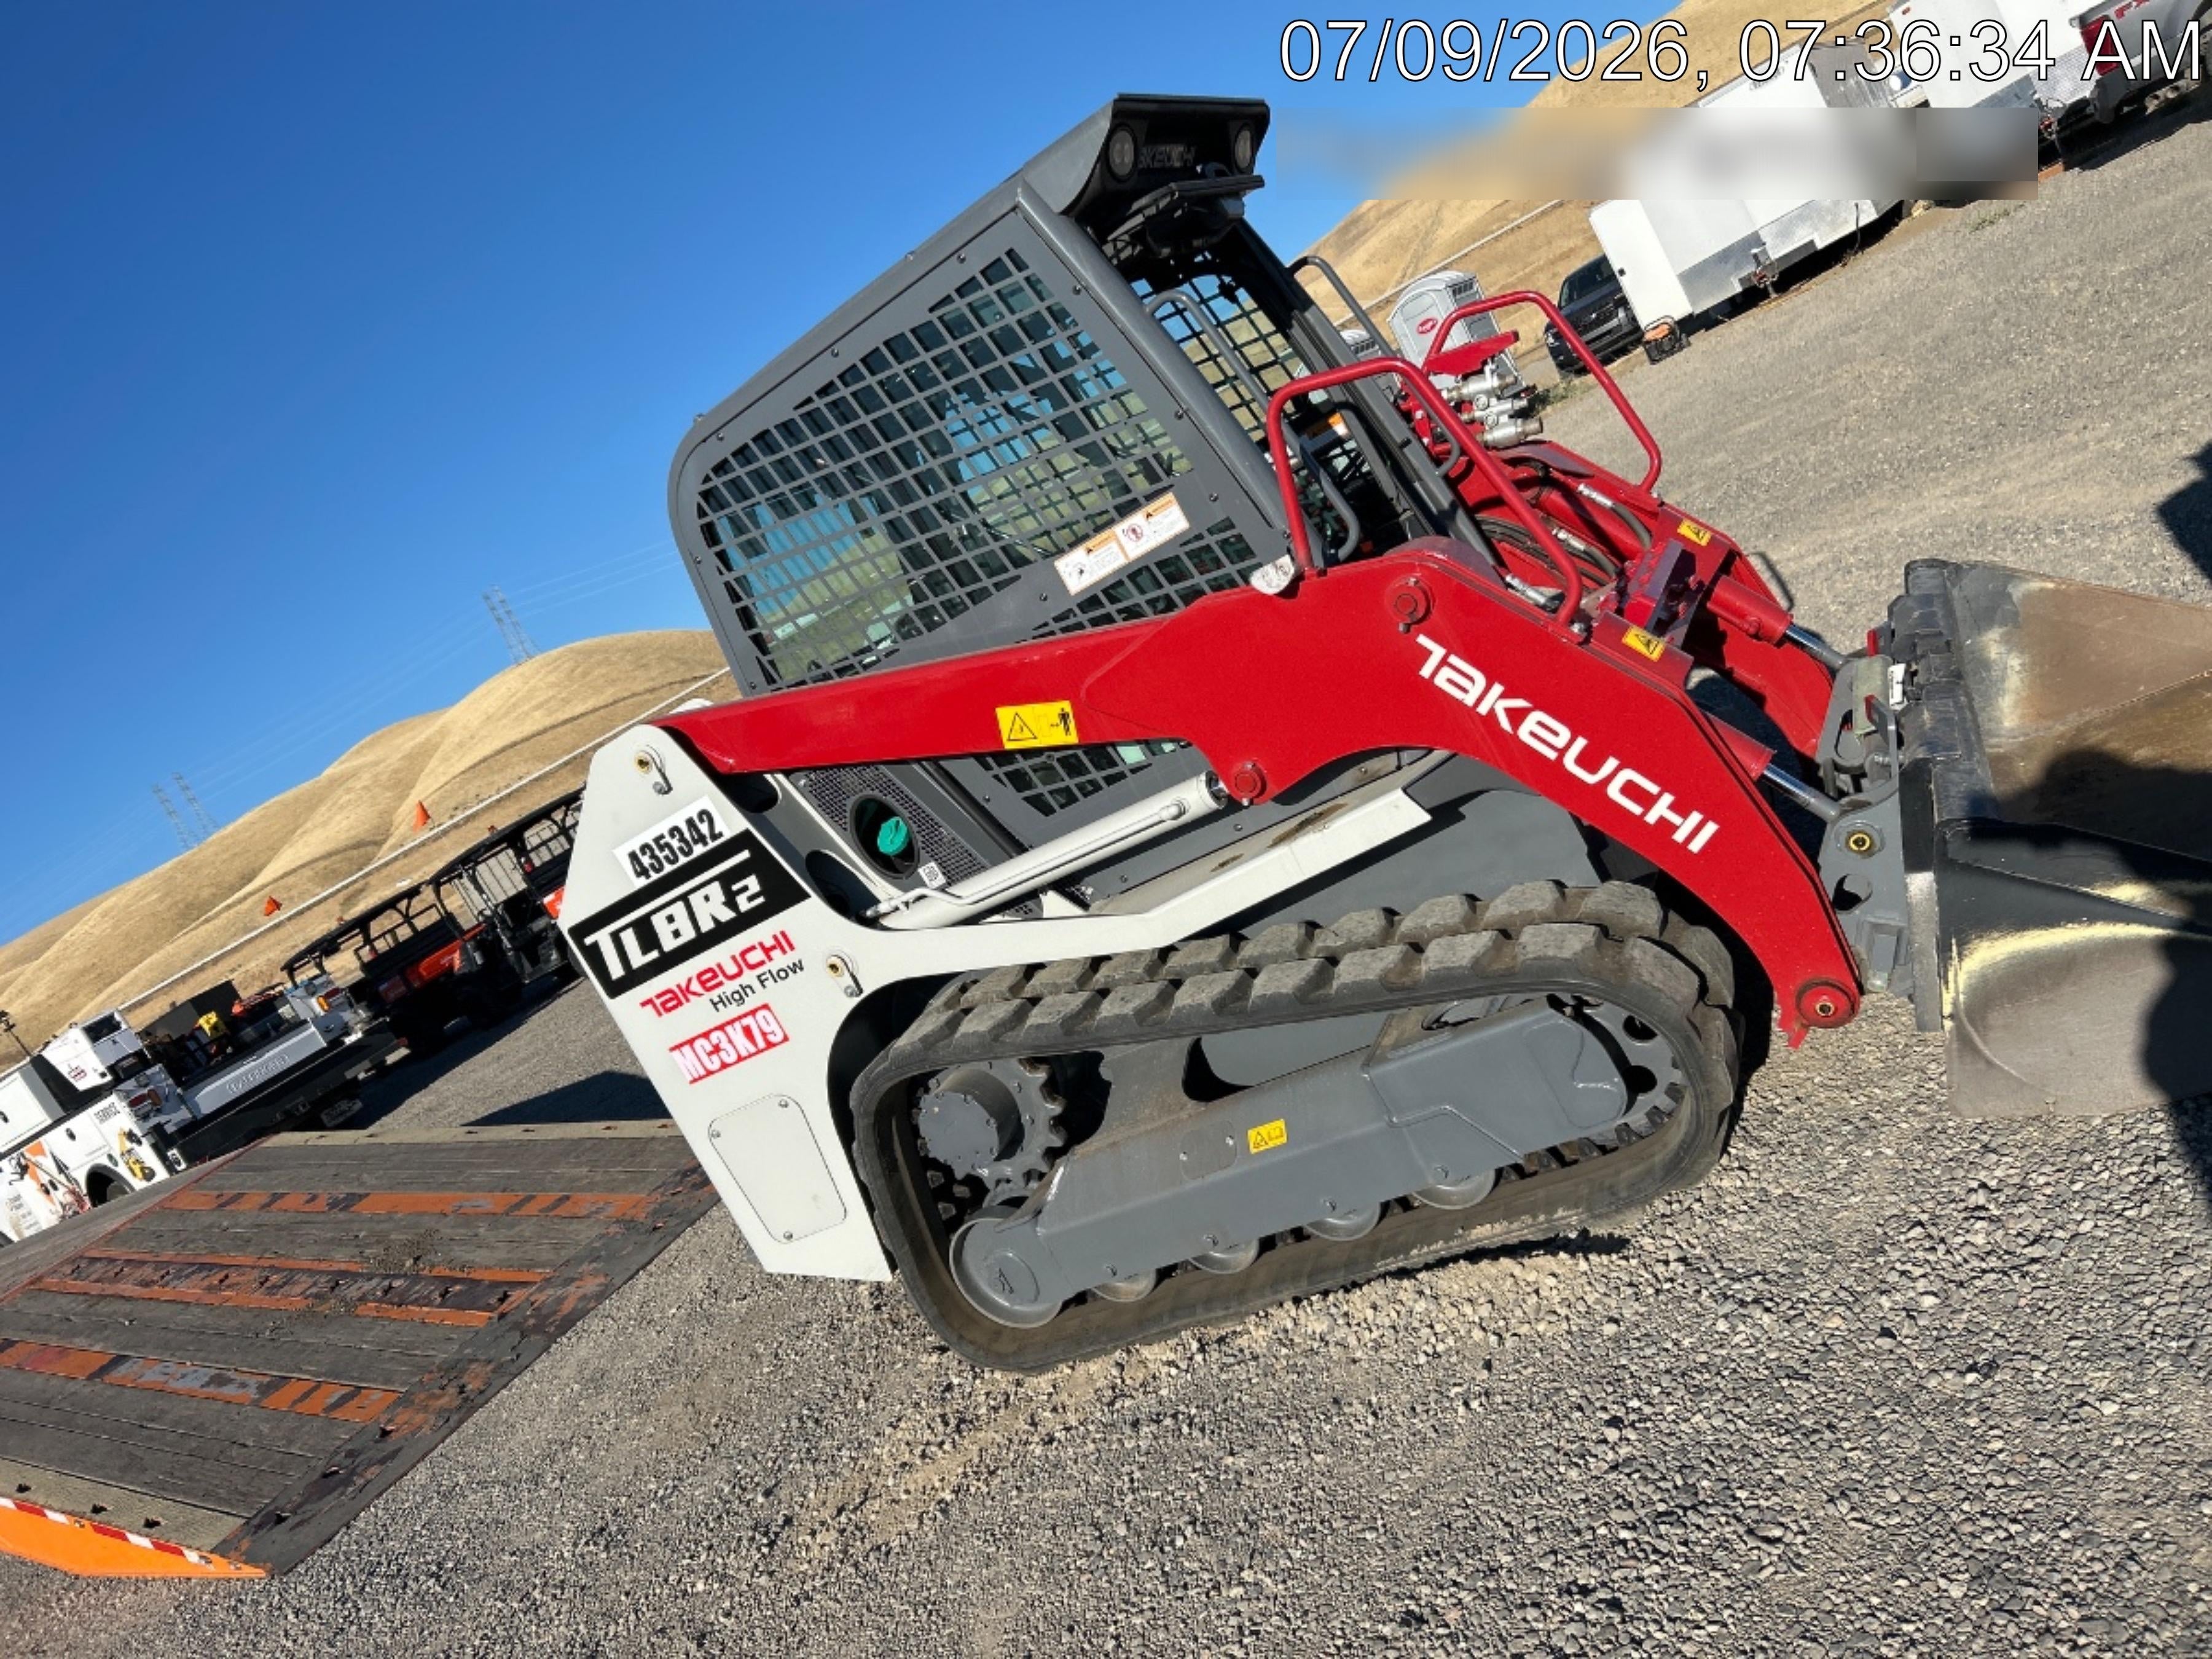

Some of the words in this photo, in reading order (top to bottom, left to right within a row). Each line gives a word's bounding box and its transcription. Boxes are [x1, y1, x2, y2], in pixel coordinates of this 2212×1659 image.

[628, 809, 724, 879] 435342
[710, 982, 756, 1013] High
[758, 957, 805, 990] Flow
[670, 1010, 786, 1084] MC3K79
